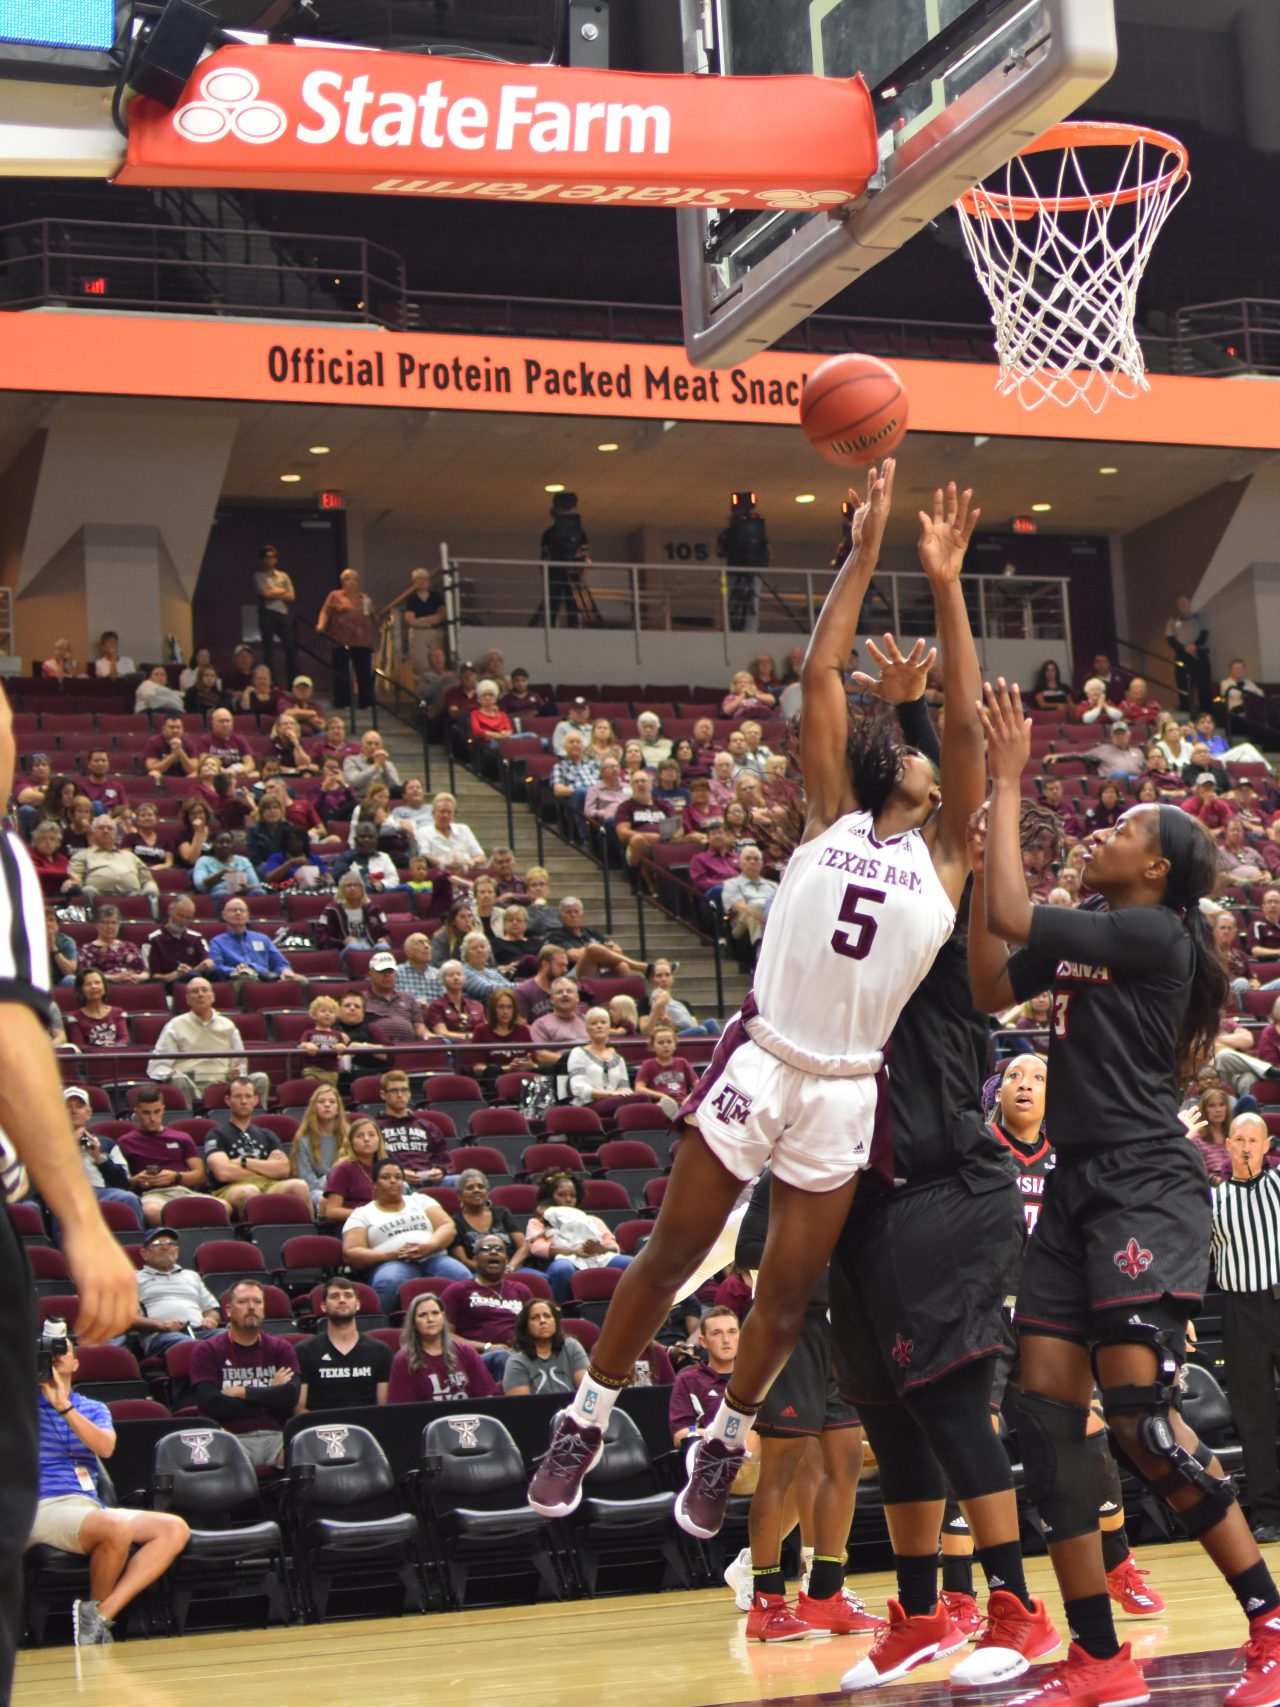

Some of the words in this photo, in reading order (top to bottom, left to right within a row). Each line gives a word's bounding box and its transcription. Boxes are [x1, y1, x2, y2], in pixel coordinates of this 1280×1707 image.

[267, 345, 384, 387] Official
[397, 352, 511, 393] Protein
[523, 358, 632, 399] Packed
[645, 364, 720, 403] Meat
[664, 542, 709, 561] 105
[818, 847, 881, 879] TEXAS
[883, 864, 923, 895] A&M
[831, 883, 887, 961] 5
[222, 1367, 254, 1381] TEXAS
[318, 1367, 350, 1378] TEXAS
[352, 1365, 371, 1377] A&M
